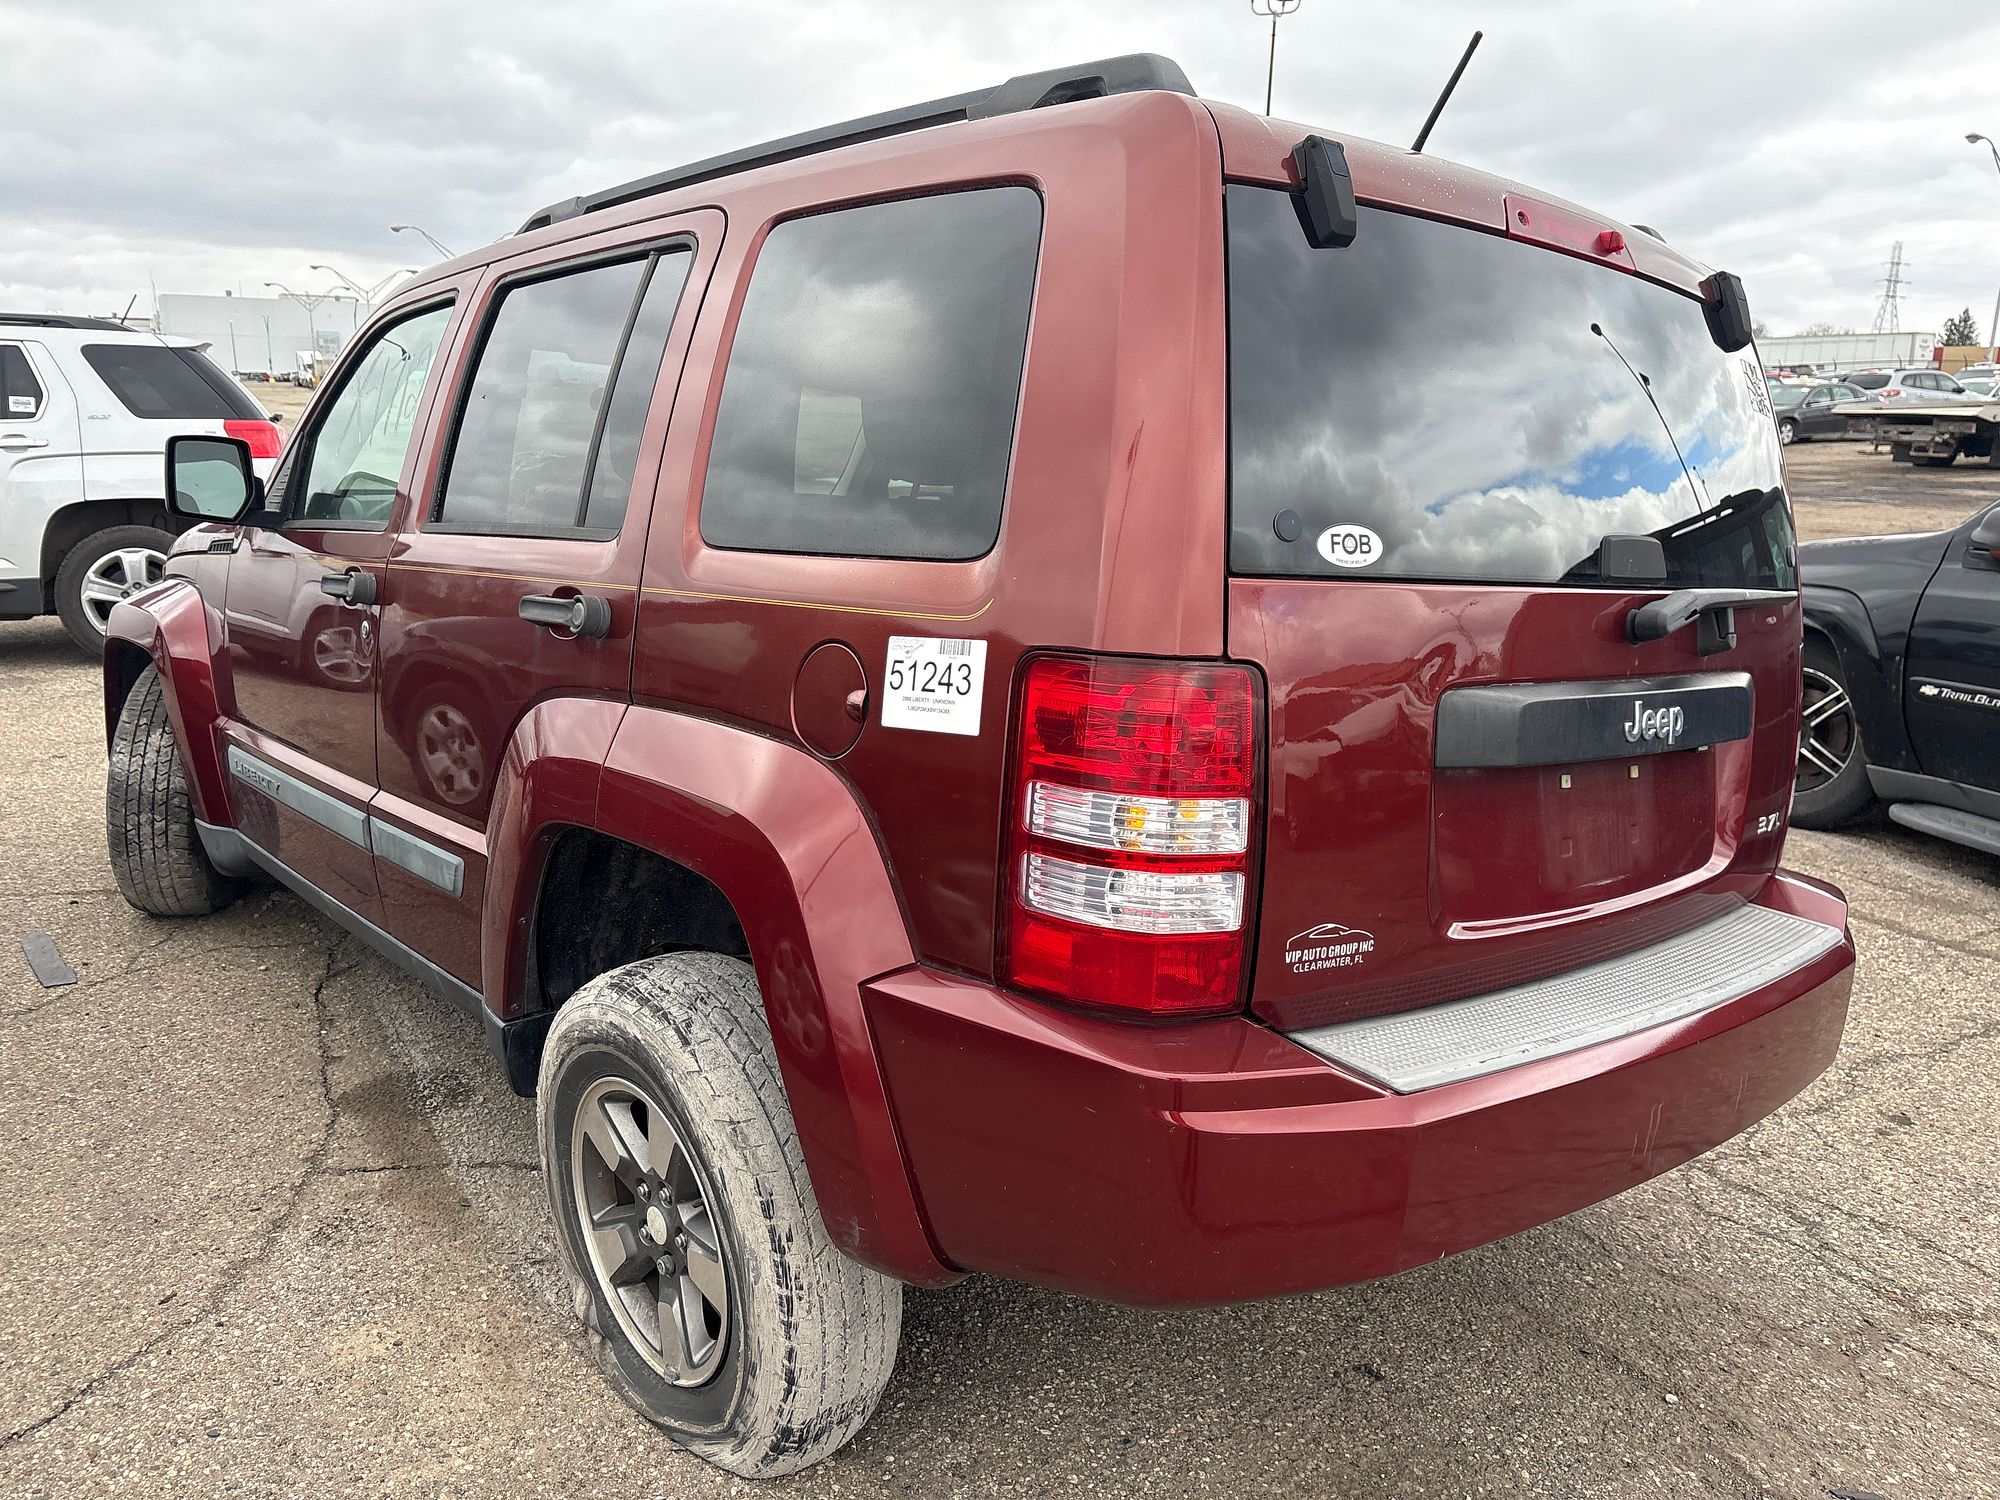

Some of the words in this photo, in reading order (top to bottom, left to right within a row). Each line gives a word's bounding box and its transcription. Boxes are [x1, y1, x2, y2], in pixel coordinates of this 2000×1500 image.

[1330, 533, 1372, 555] FOB
[889, 659, 972, 696] 51243
[1623, 700, 1684, 745] Jeep
[234, 759, 281, 796] LIBERTY
[1285, 950, 1301, 964] VIP
[1302, 946, 1328, 961] AUTO
[1328, 942, 1359, 958] GROUP
[1359, 939, 1375, 953] INC
[1293, 956, 1353, 973] CLEARWATER,
[1354, 954, 1364, 964] FL
